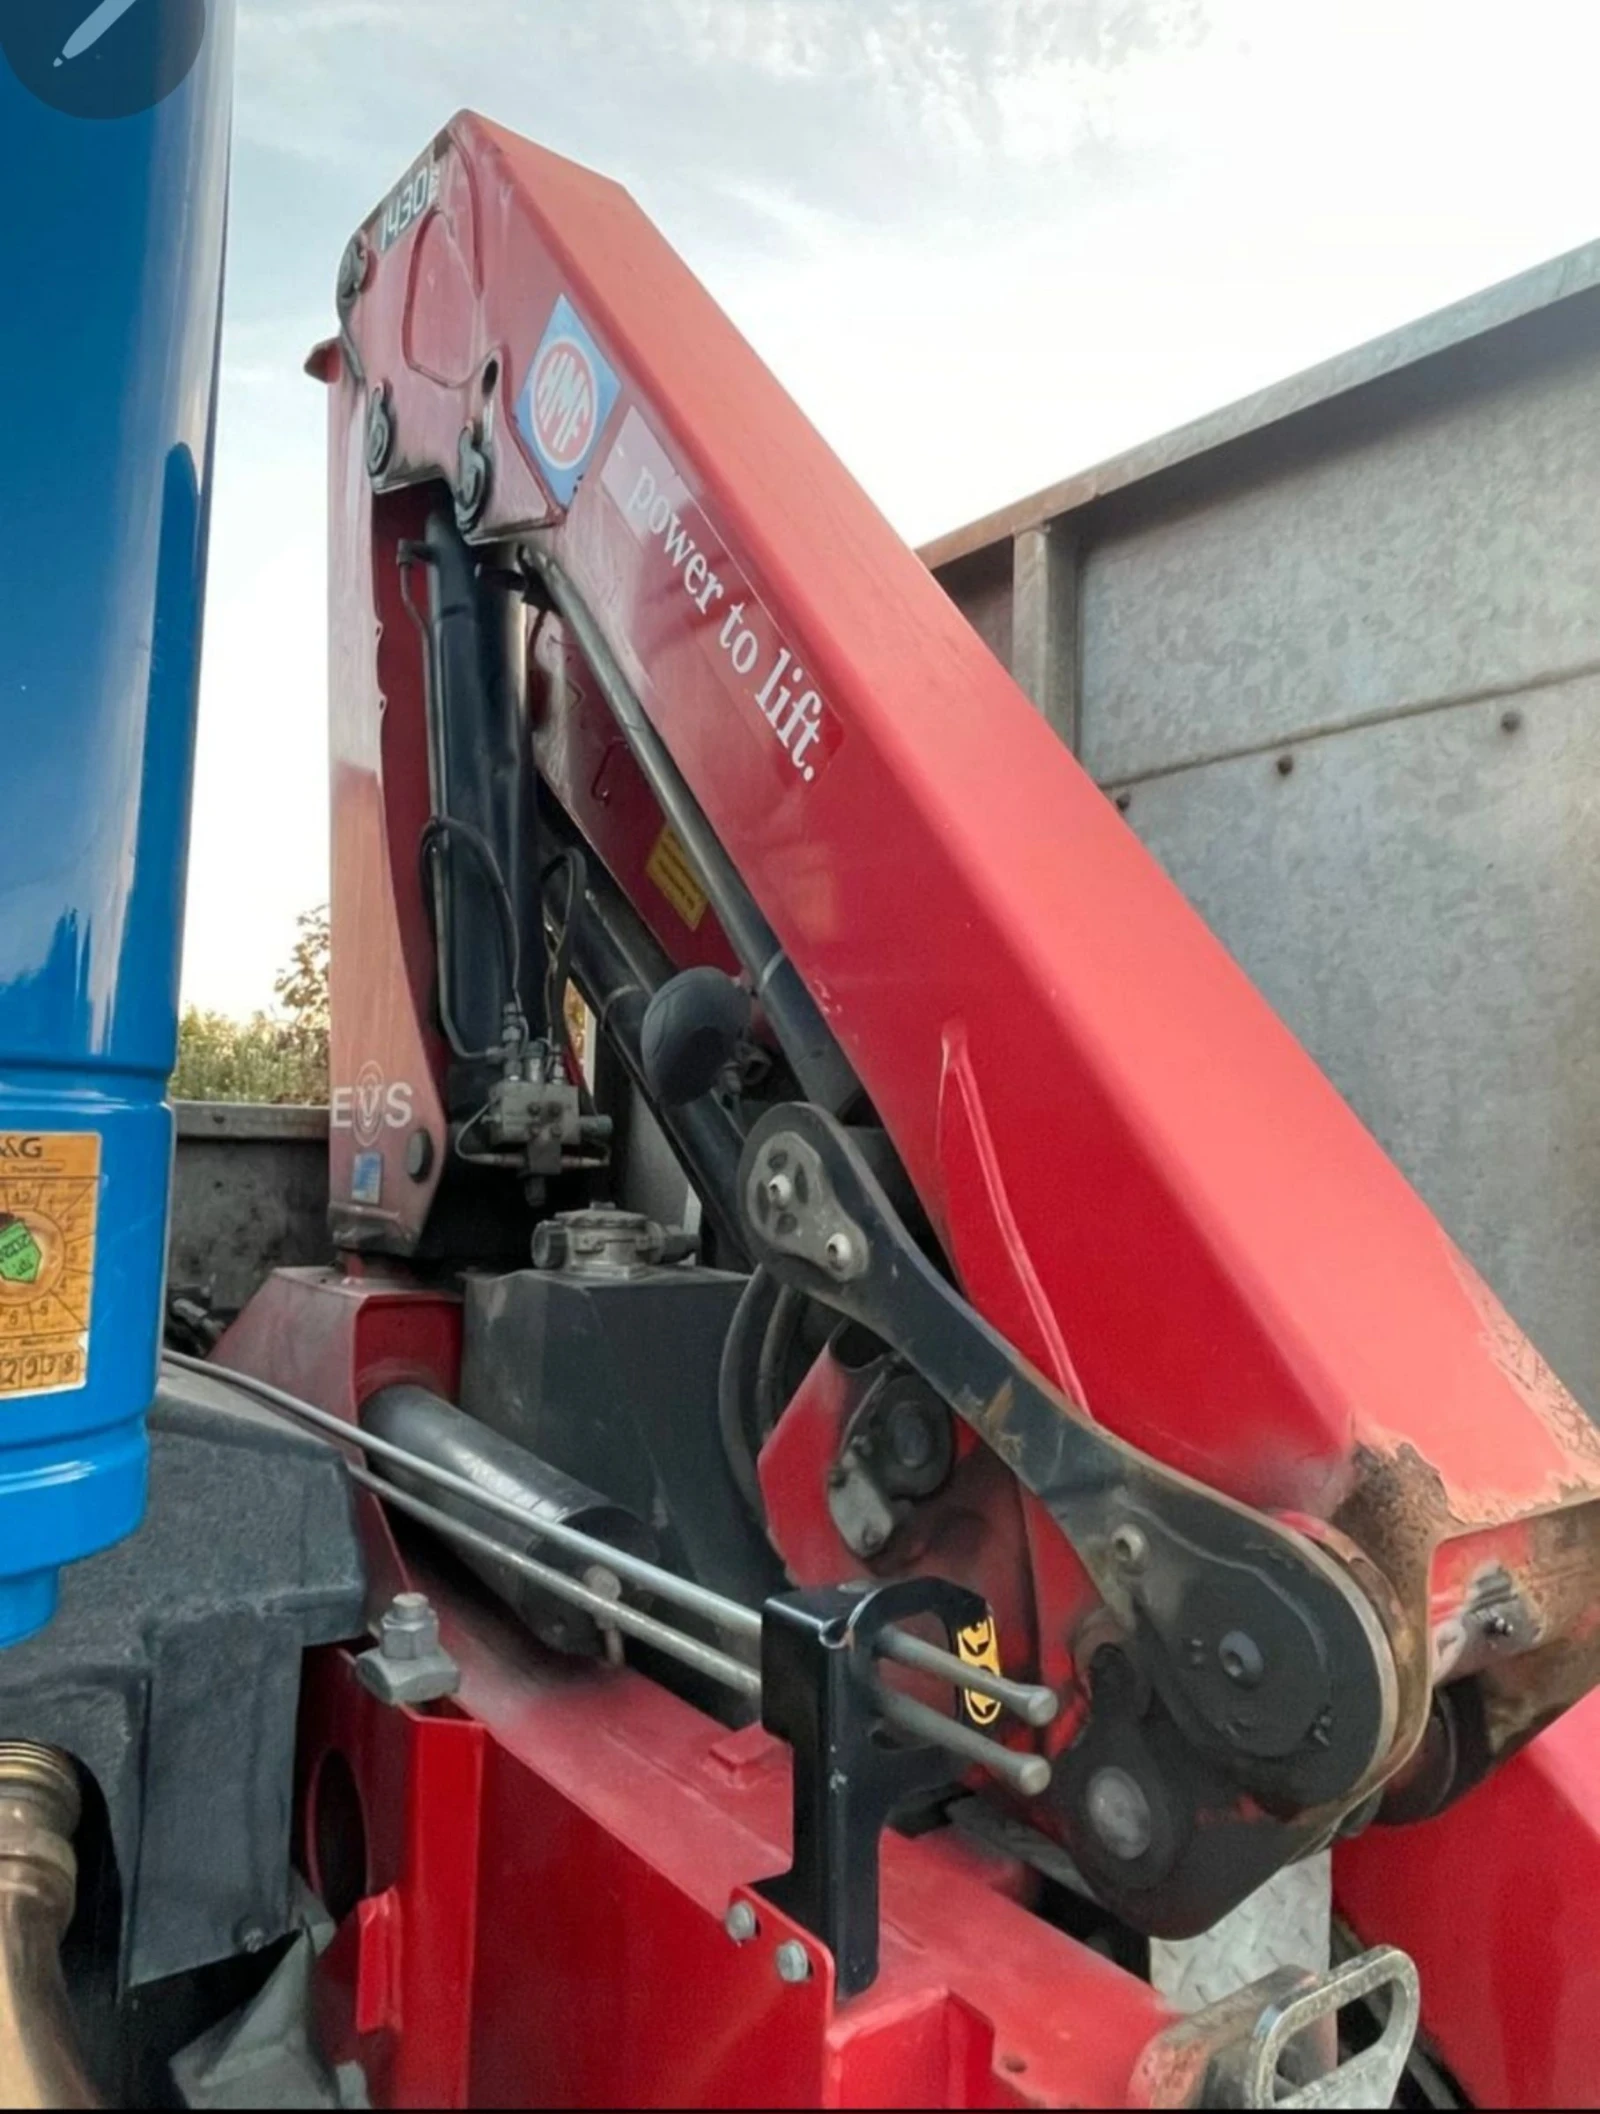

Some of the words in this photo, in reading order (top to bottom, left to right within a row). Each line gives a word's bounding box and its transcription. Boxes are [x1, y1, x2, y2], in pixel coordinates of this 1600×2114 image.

[380, 165, 428, 252] 1430
[537, 351, 590, 453] HMF
[625, 465, 724, 615] power
[719, 602, 758, 674] to
[754, 647, 823, 782] lift.
[328, 1080, 413, 1129] EVS
